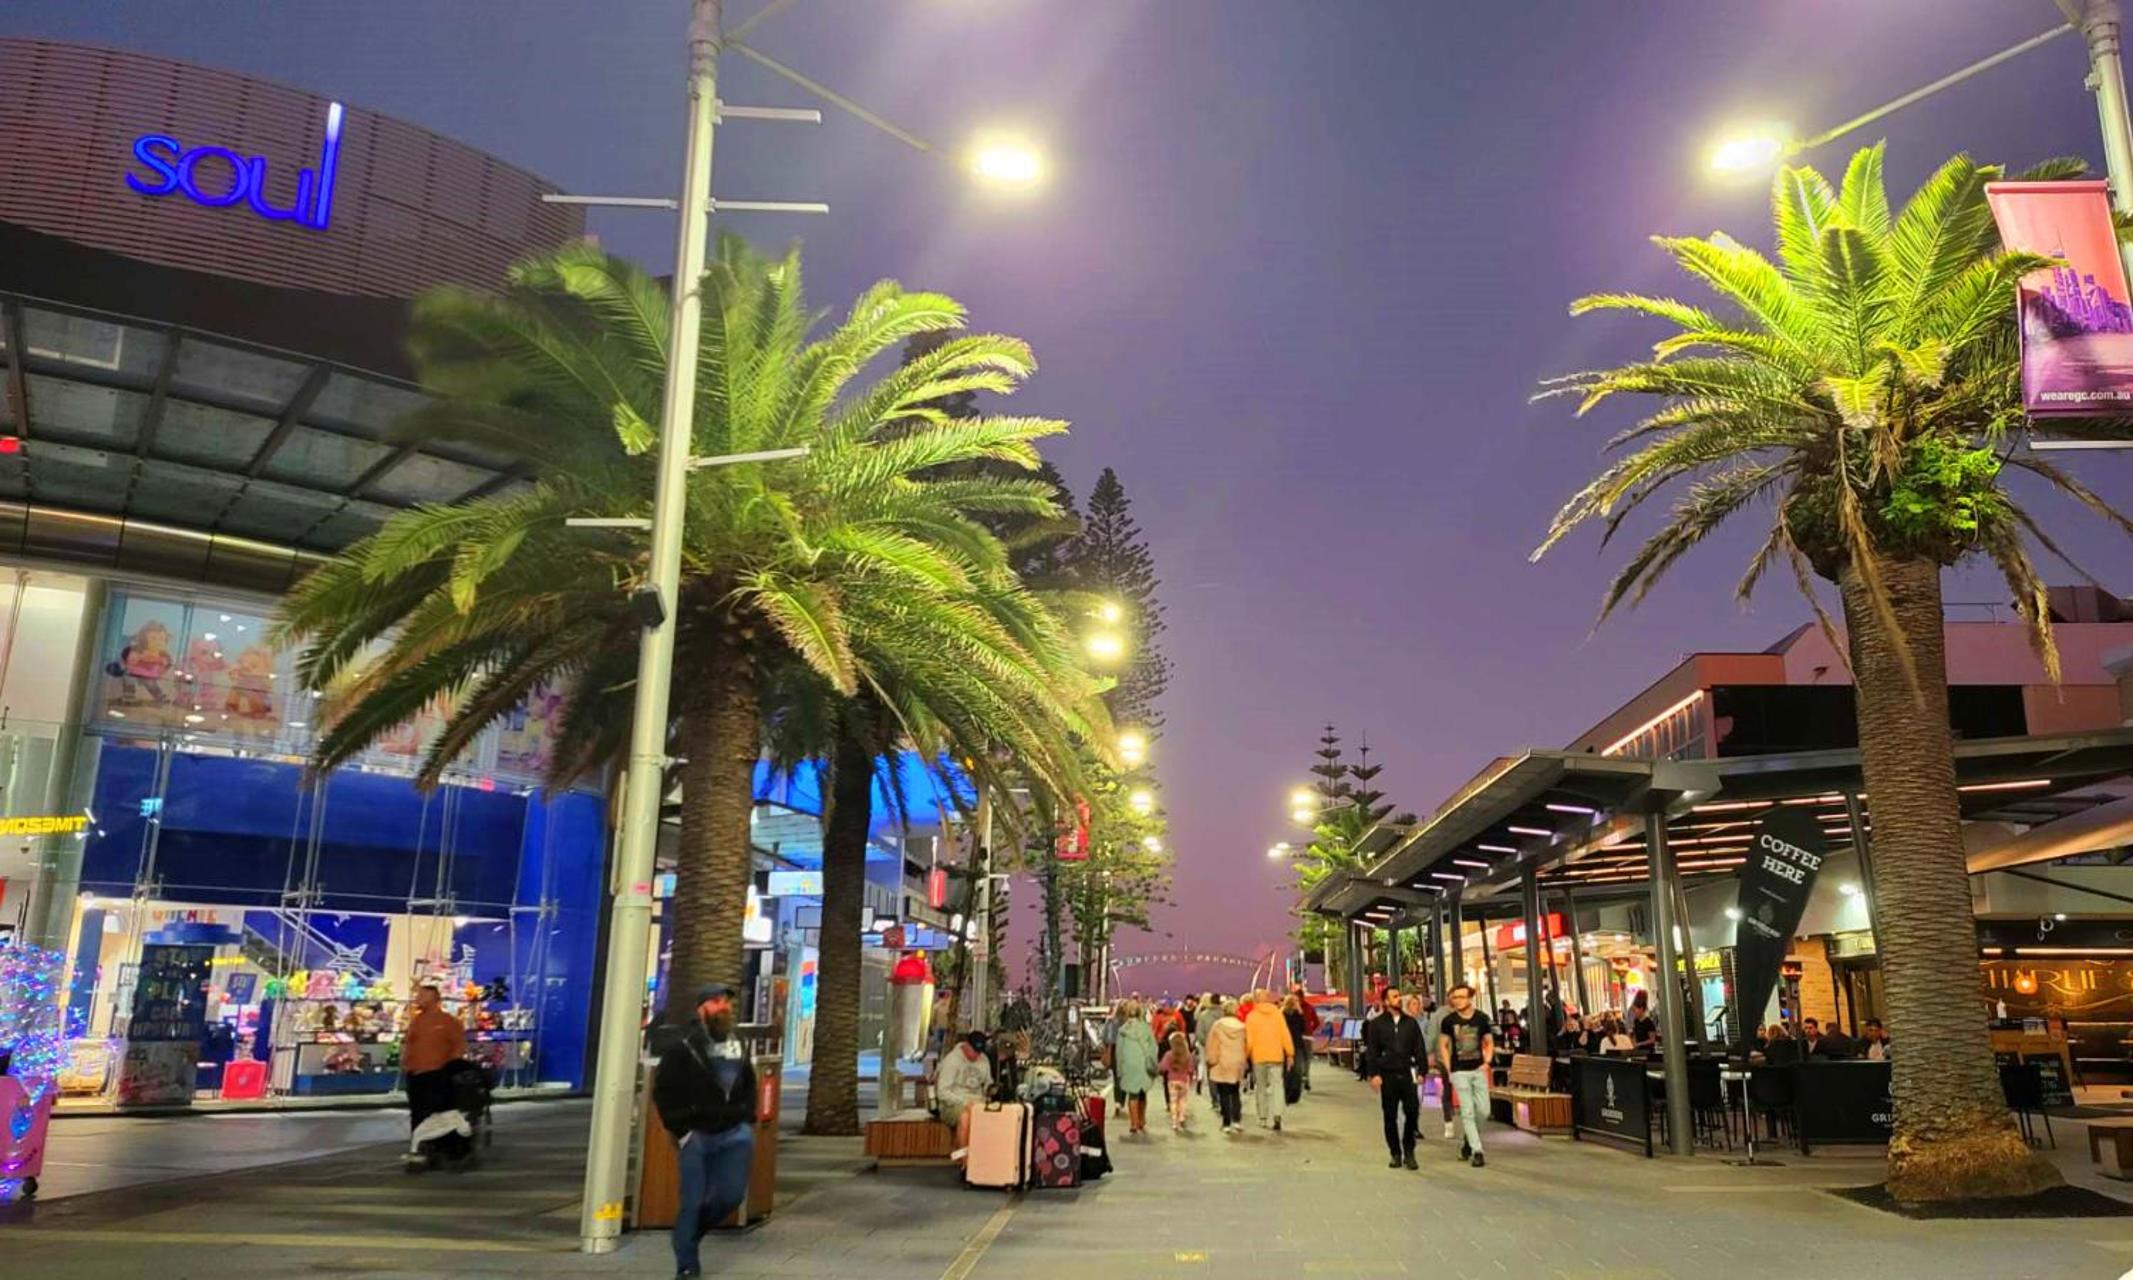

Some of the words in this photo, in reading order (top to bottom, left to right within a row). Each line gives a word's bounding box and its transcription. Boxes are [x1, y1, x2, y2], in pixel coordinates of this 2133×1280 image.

[125, 102, 343, 231] soul
[2040, 391, 2131, 402] wearegc.com.au
[1760, 834, 1822, 871] COFFEE
[1762, 855, 1806, 885] HERE
